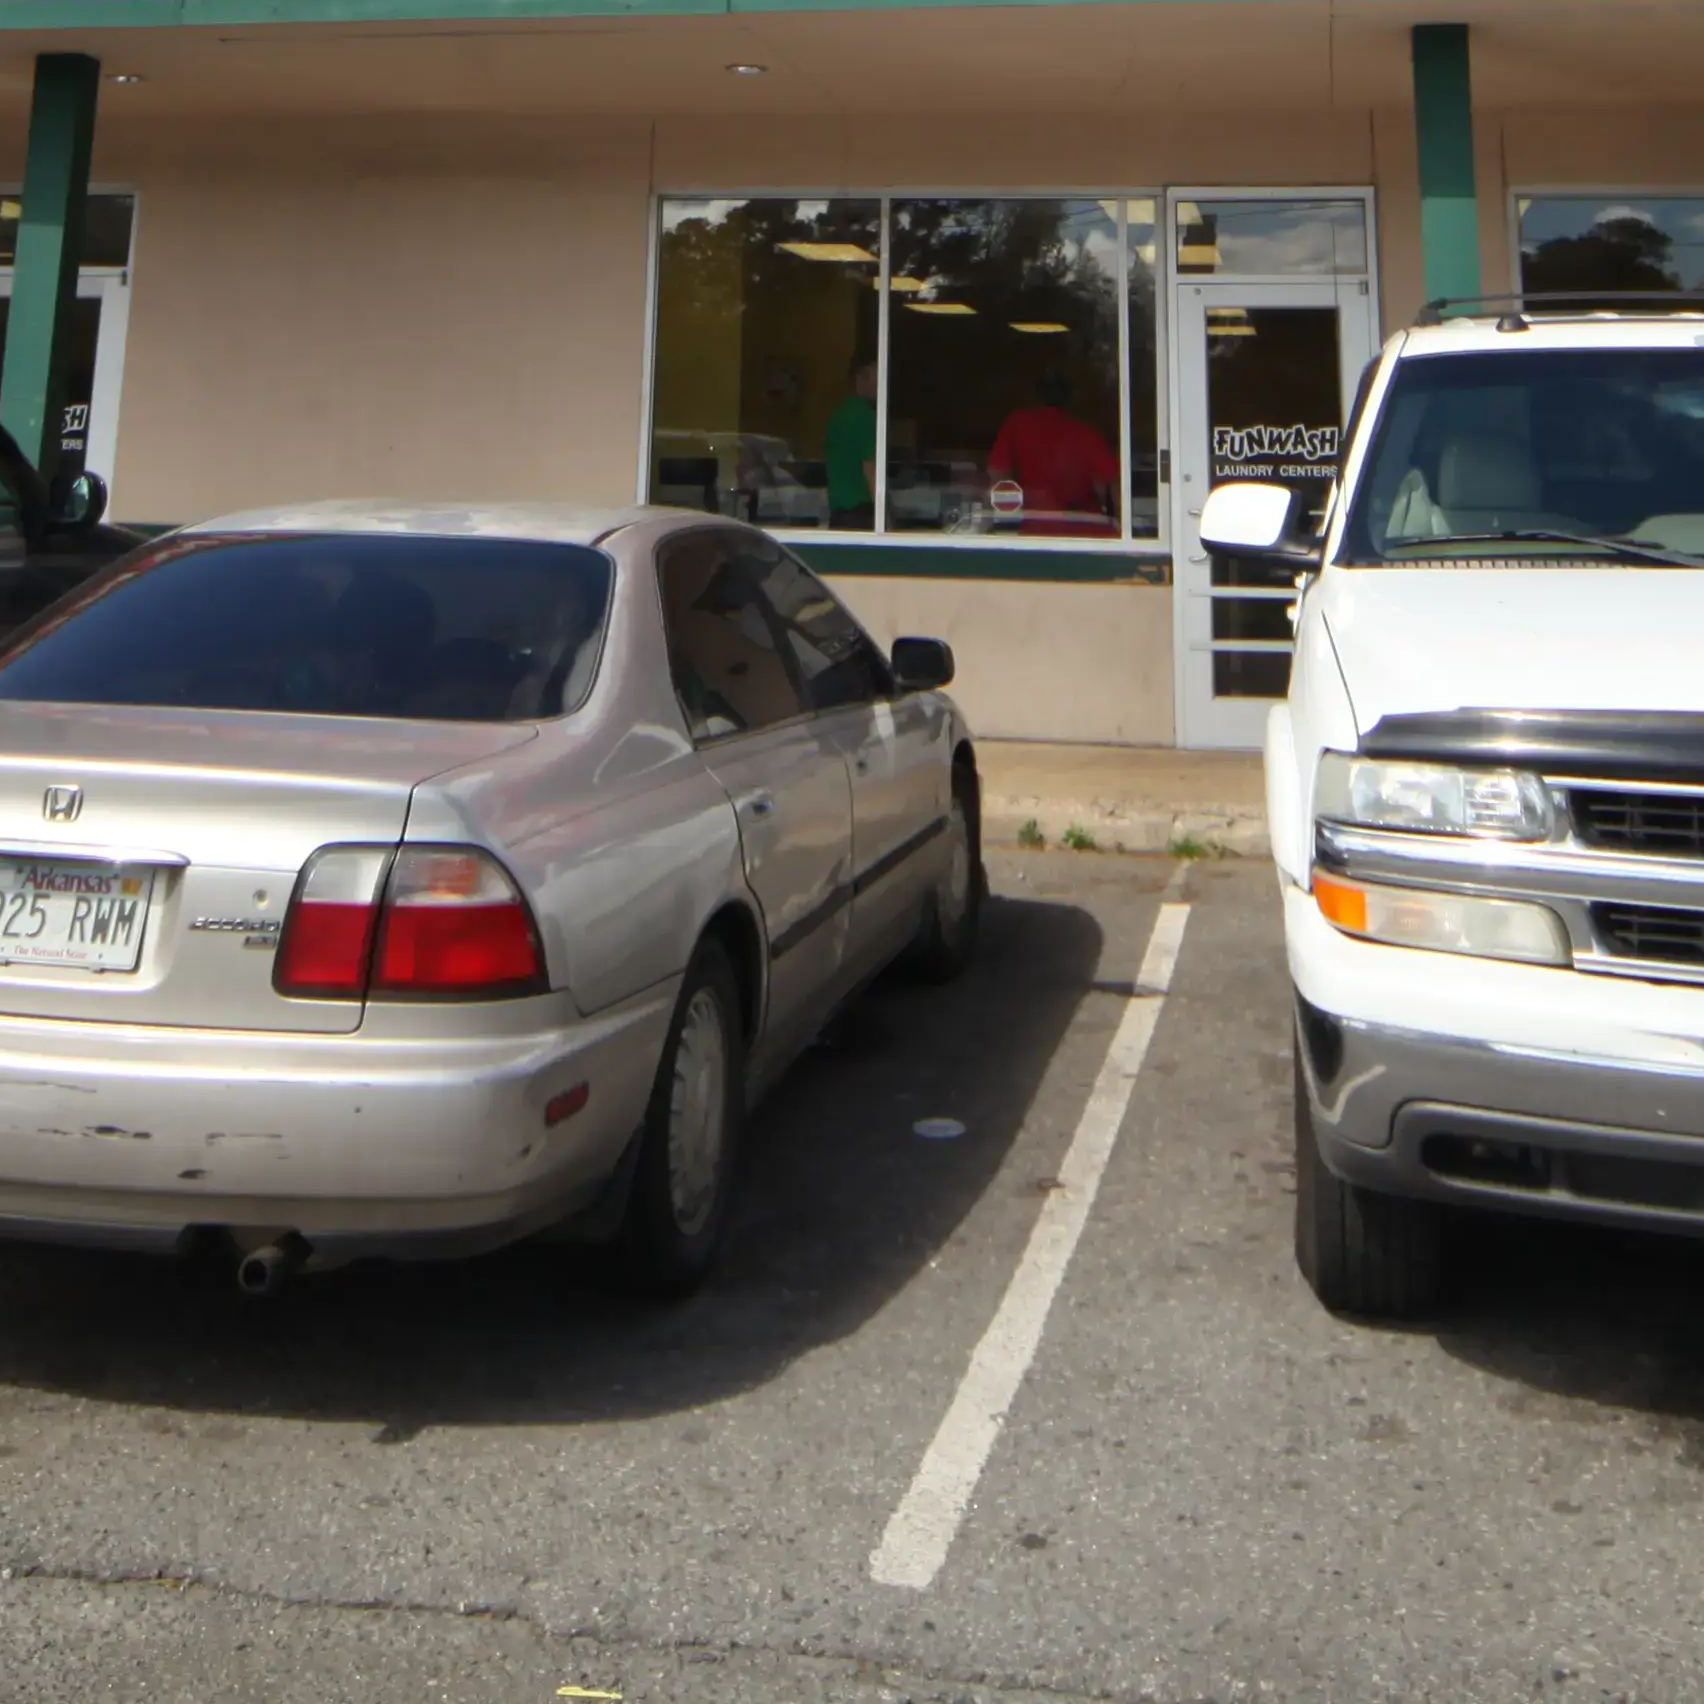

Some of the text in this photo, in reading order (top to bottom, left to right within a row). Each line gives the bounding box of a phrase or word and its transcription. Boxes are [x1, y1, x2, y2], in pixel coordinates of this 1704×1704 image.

[1214, 424, 1338, 460] FUNWASH
[1216, 465, 1337, 476] LAUNDRY CENTERS
[21, 867, 114, 894] Arkansas
[67, 896, 138, 947] RWM
